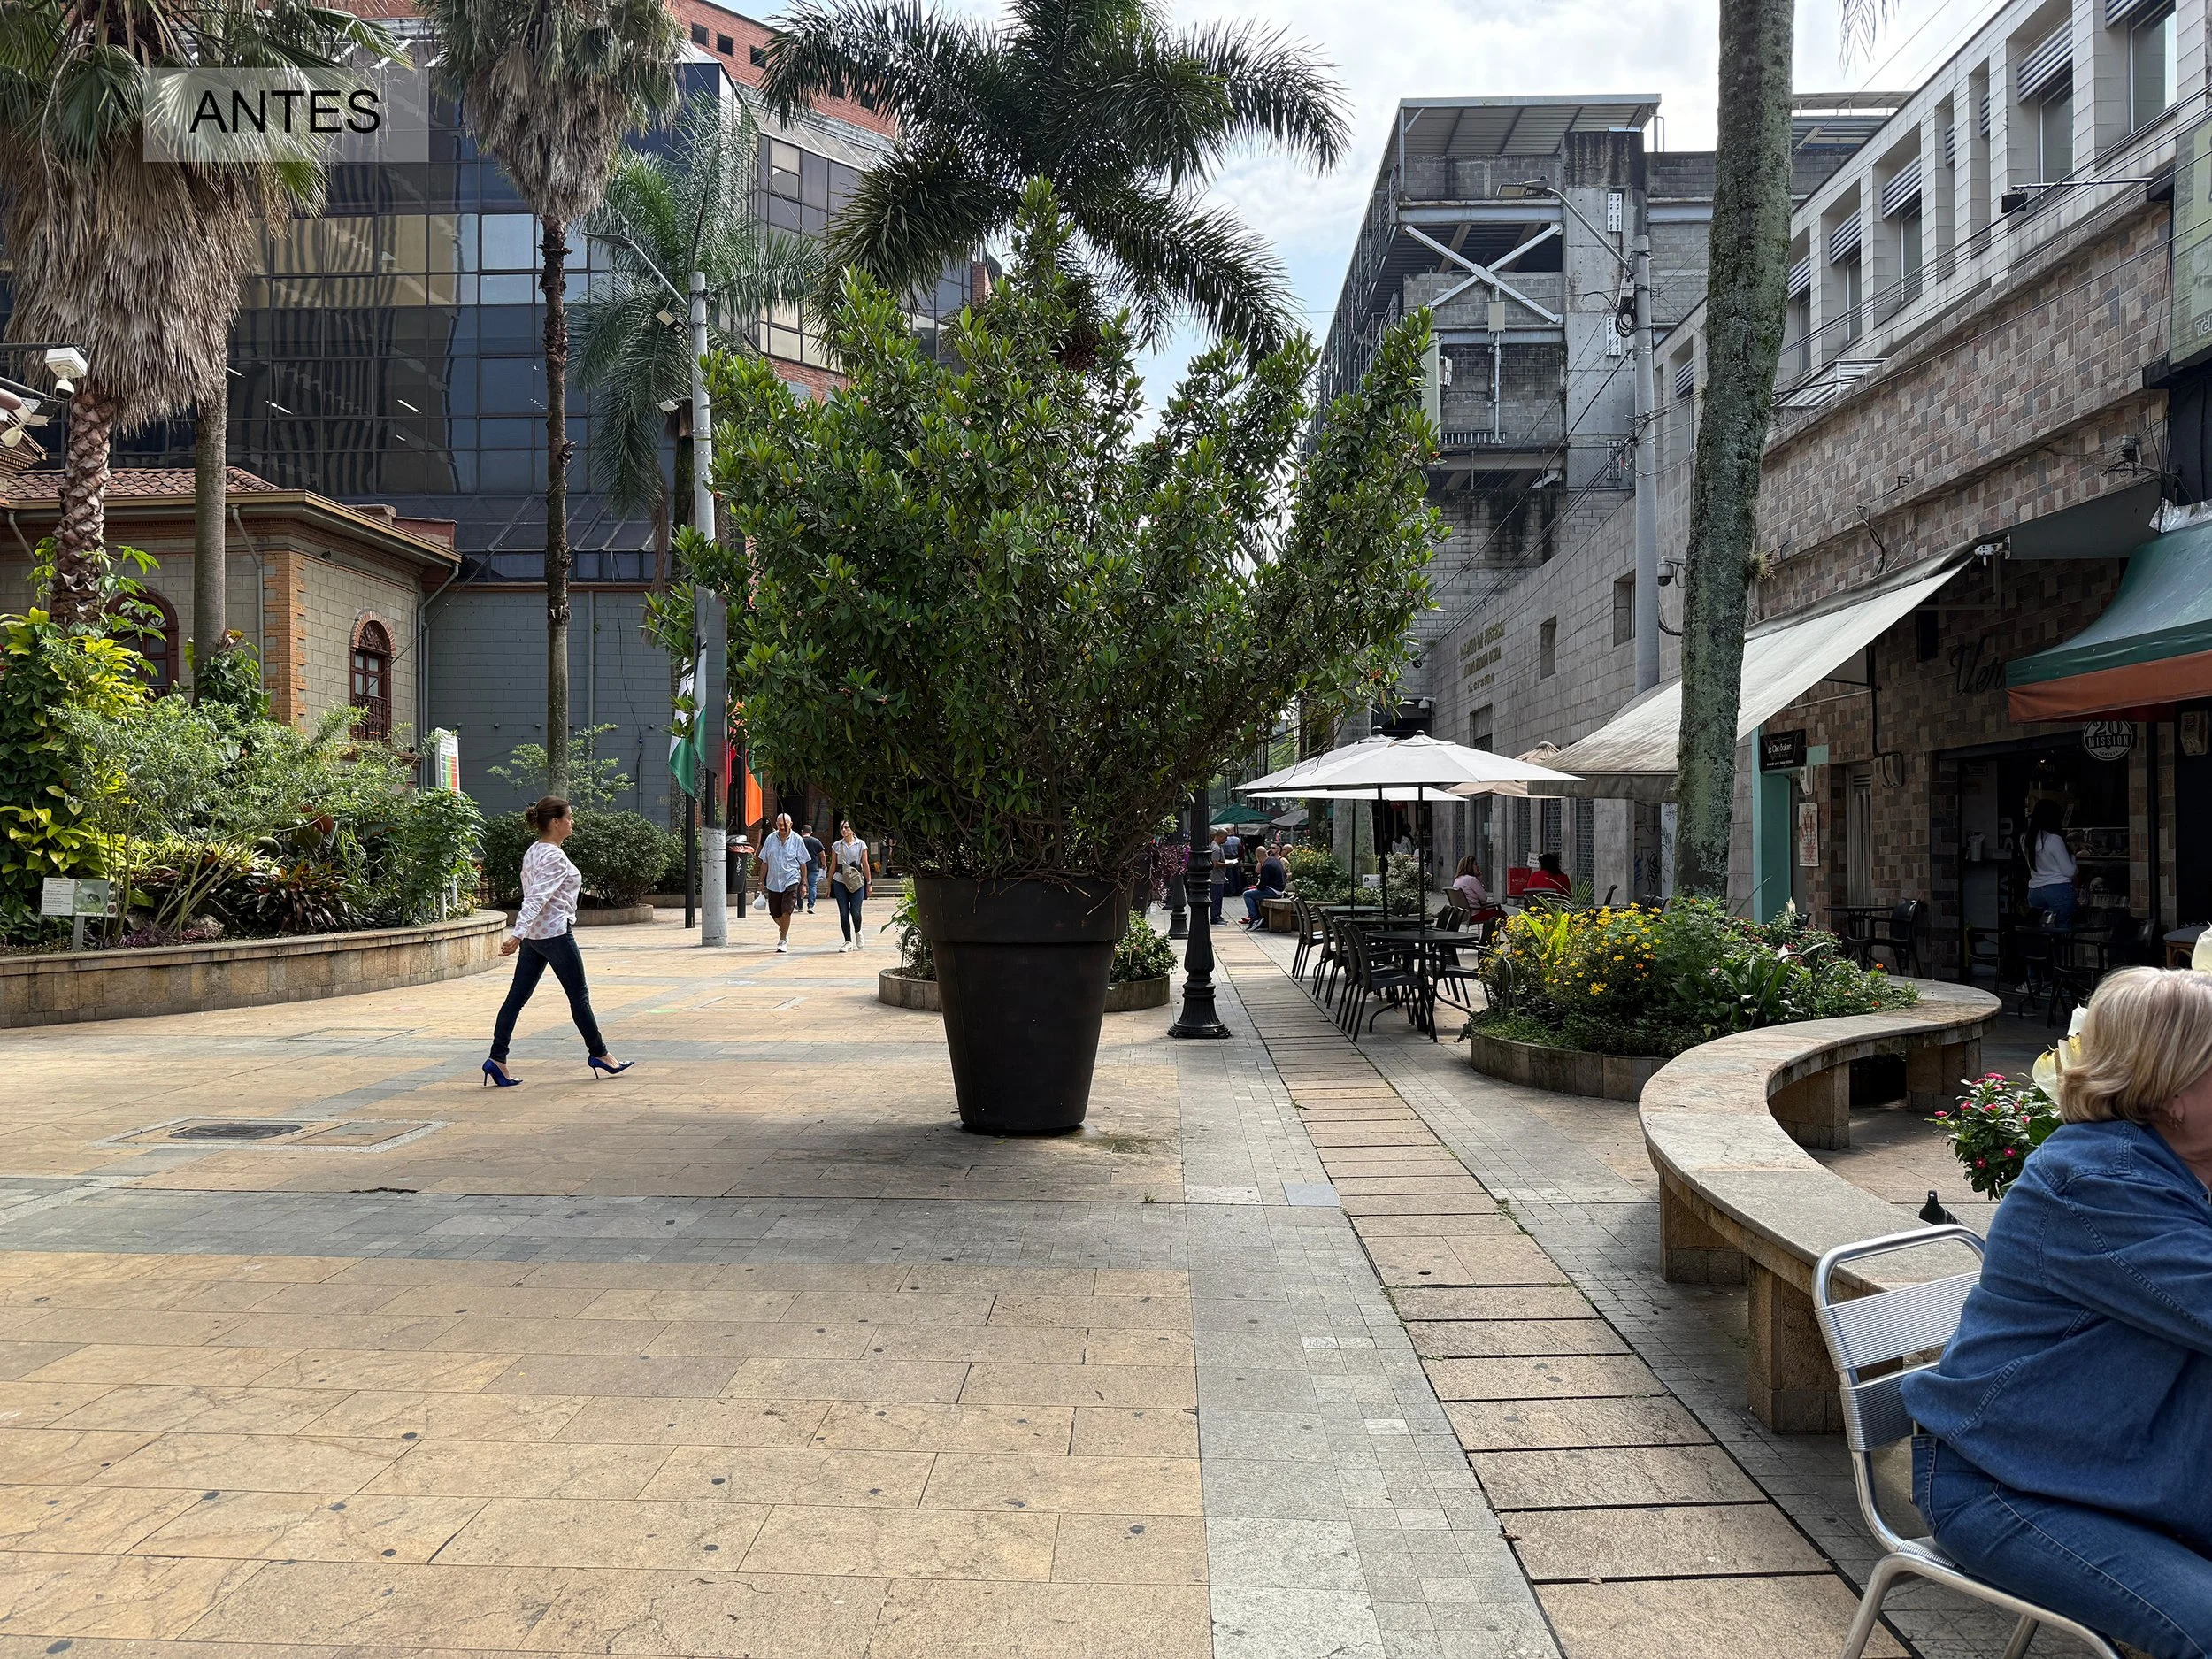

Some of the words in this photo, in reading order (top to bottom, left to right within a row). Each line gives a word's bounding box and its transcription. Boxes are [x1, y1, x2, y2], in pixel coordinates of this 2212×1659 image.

[1950, 633, 2004, 695] Ver
[2093, 721, 2123, 735] 20
[2088, 735, 2128, 748] MISSION
